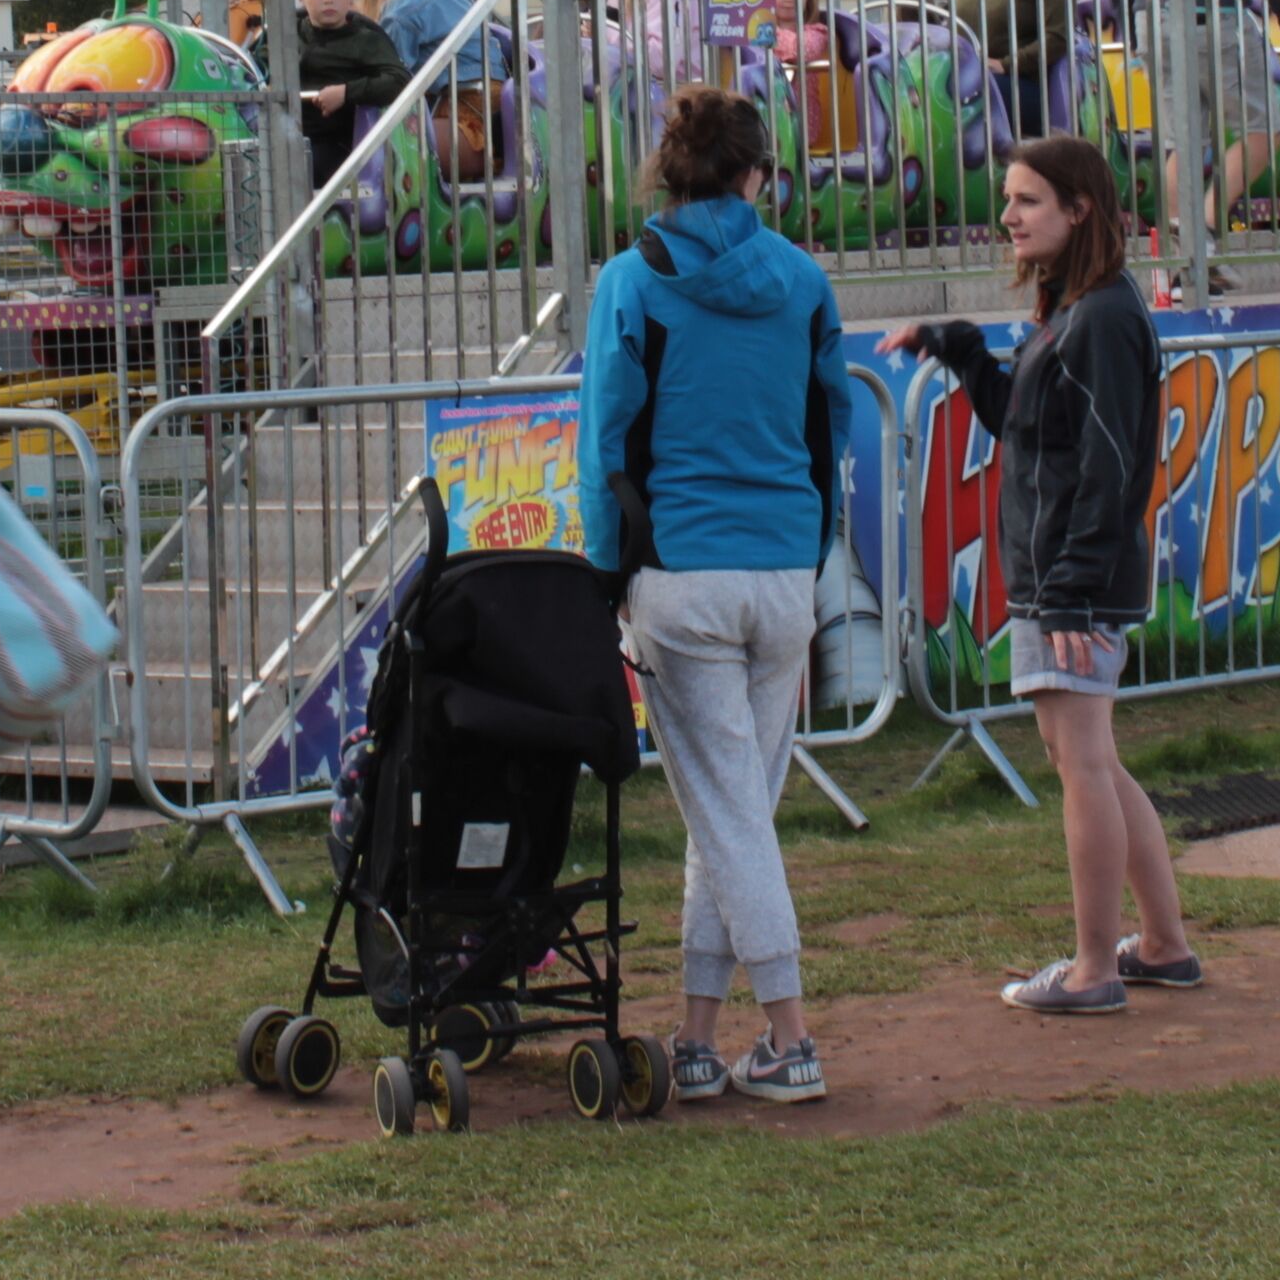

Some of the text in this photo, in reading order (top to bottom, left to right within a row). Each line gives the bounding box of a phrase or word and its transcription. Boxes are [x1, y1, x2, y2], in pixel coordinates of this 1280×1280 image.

[431, 423, 477, 460] GIANT
[434, 419, 579, 511] FUNFA
[475, 506, 509, 549] FREE
[507, 501, 548, 548] ENTRY
[678, 1061, 714, 1084] NIKE
[788, 1060, 821, 1085] NIK
